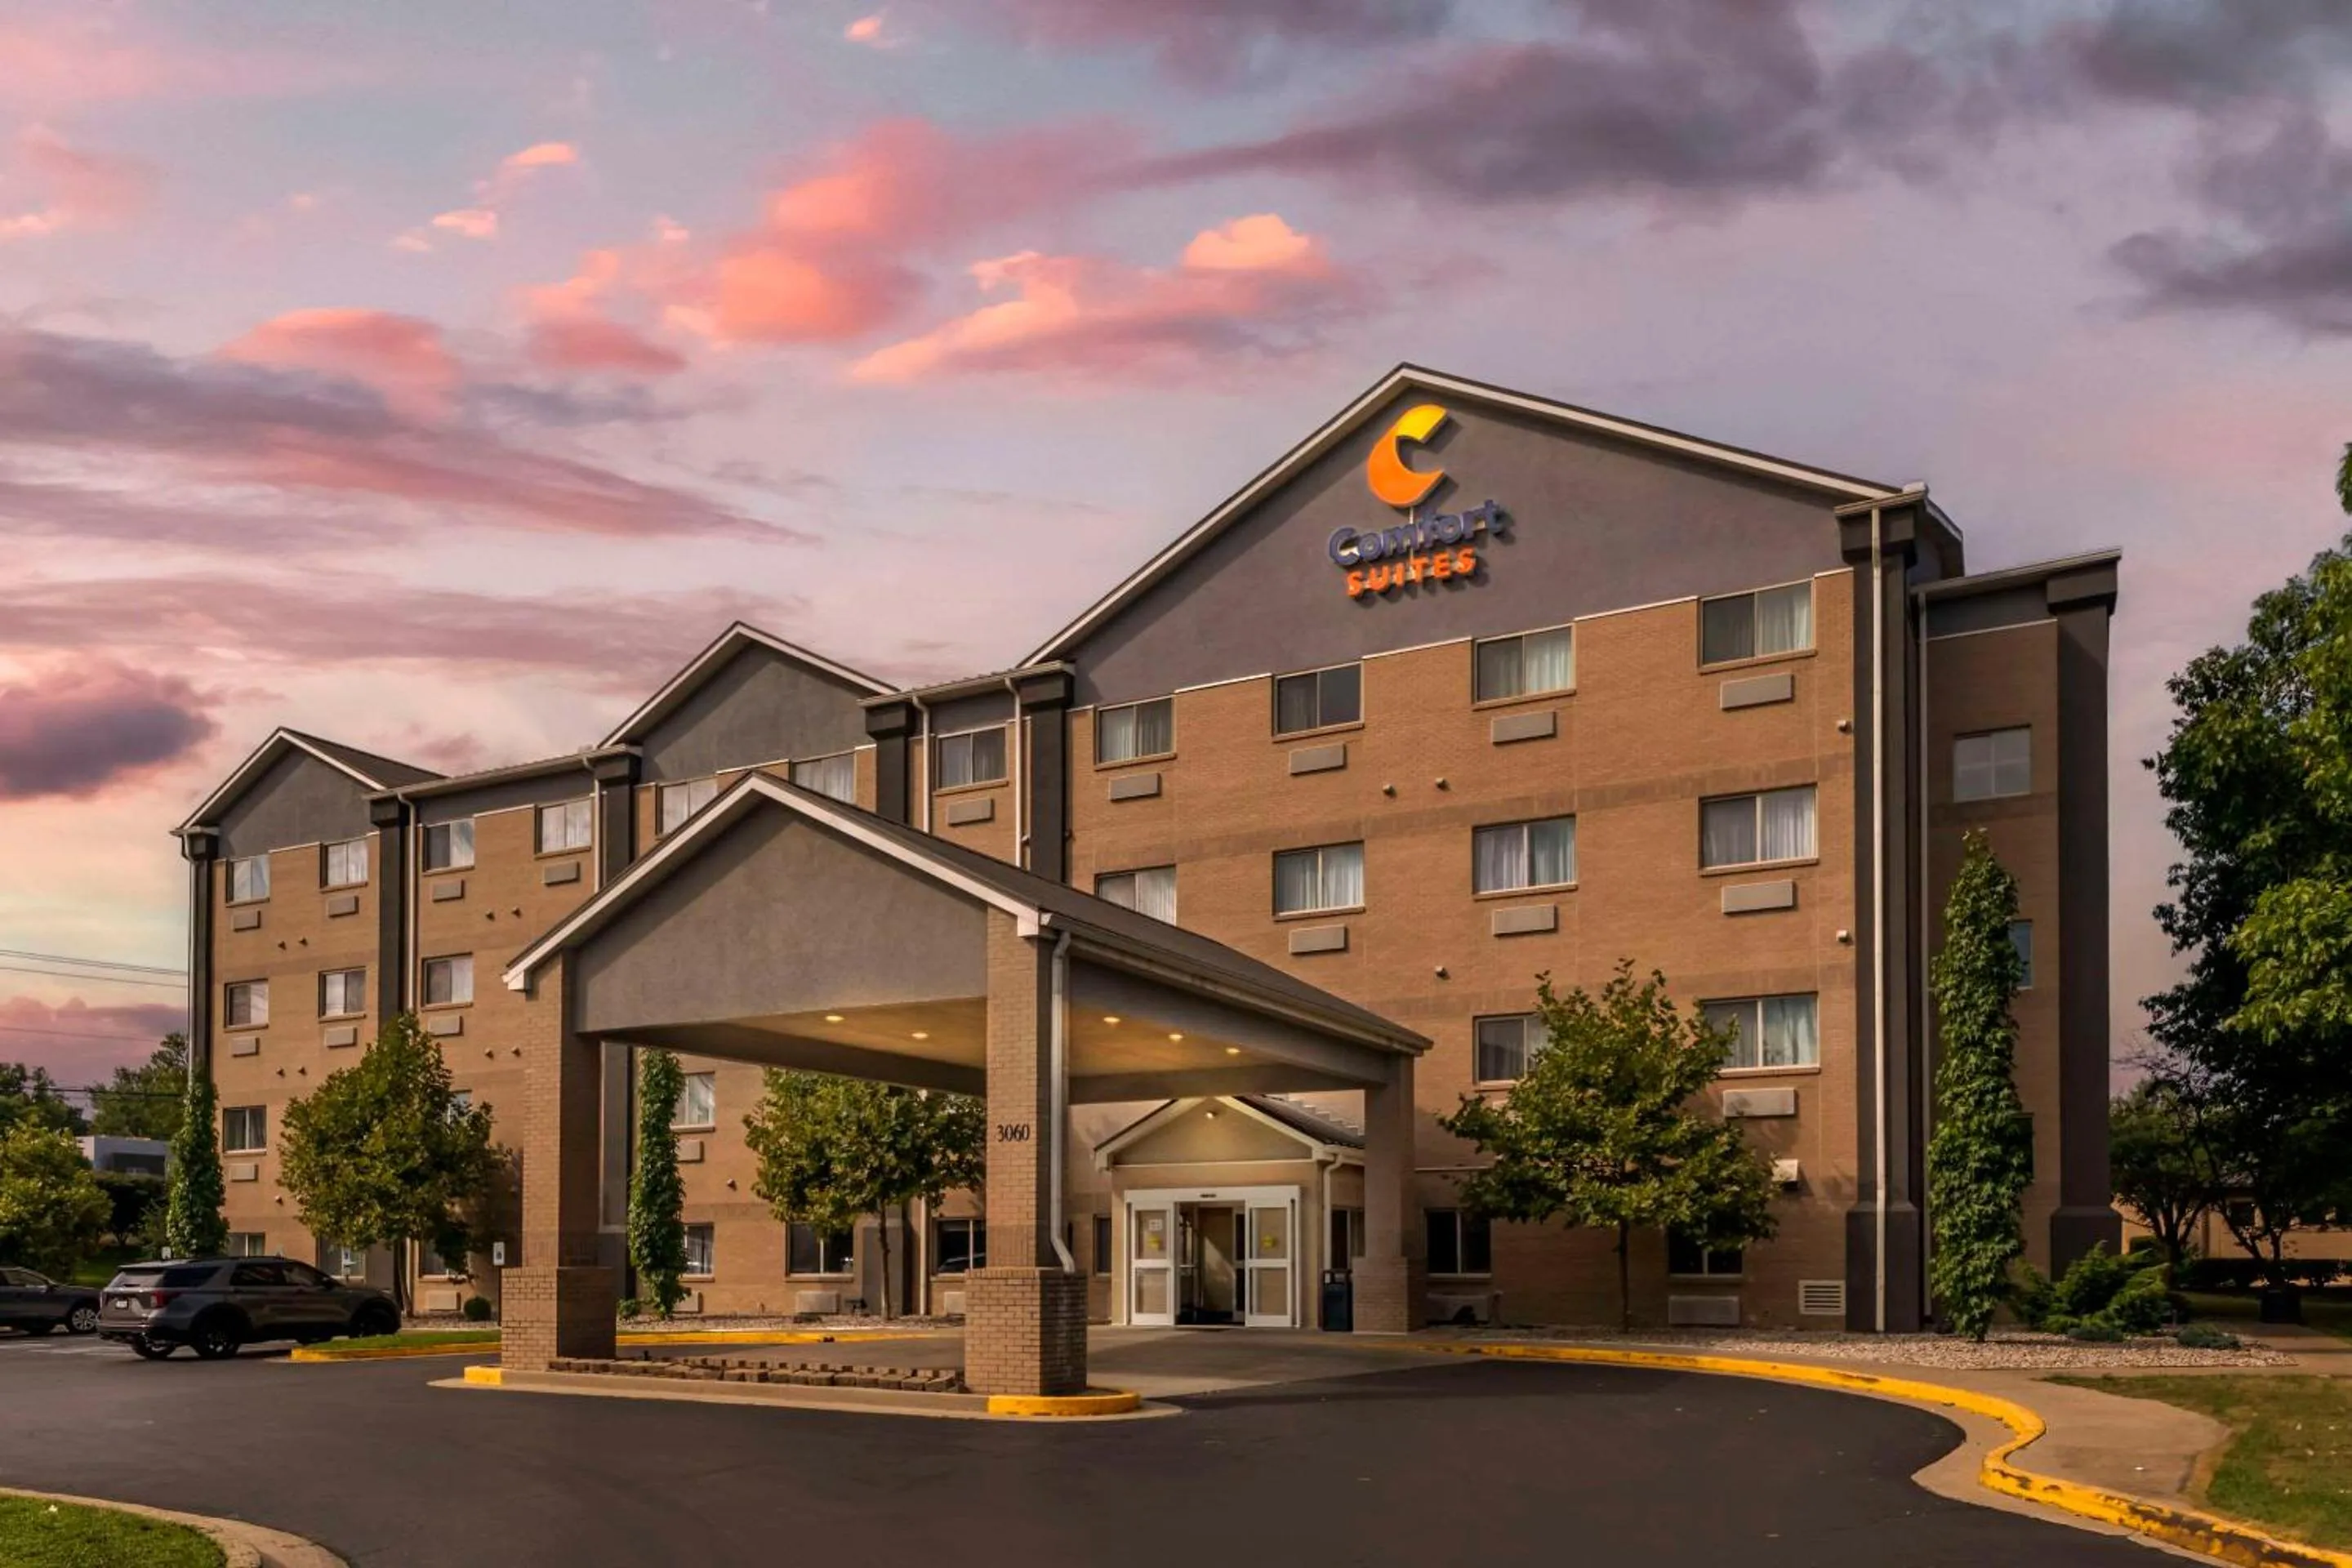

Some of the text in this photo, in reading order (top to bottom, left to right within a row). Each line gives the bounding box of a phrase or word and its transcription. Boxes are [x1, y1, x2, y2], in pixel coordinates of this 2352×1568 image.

[1330, 500, 1499, 565] Comfort
[1348, 546, 1477, 598] SUITES
[996, 1124, 1030, 1143] 3060
